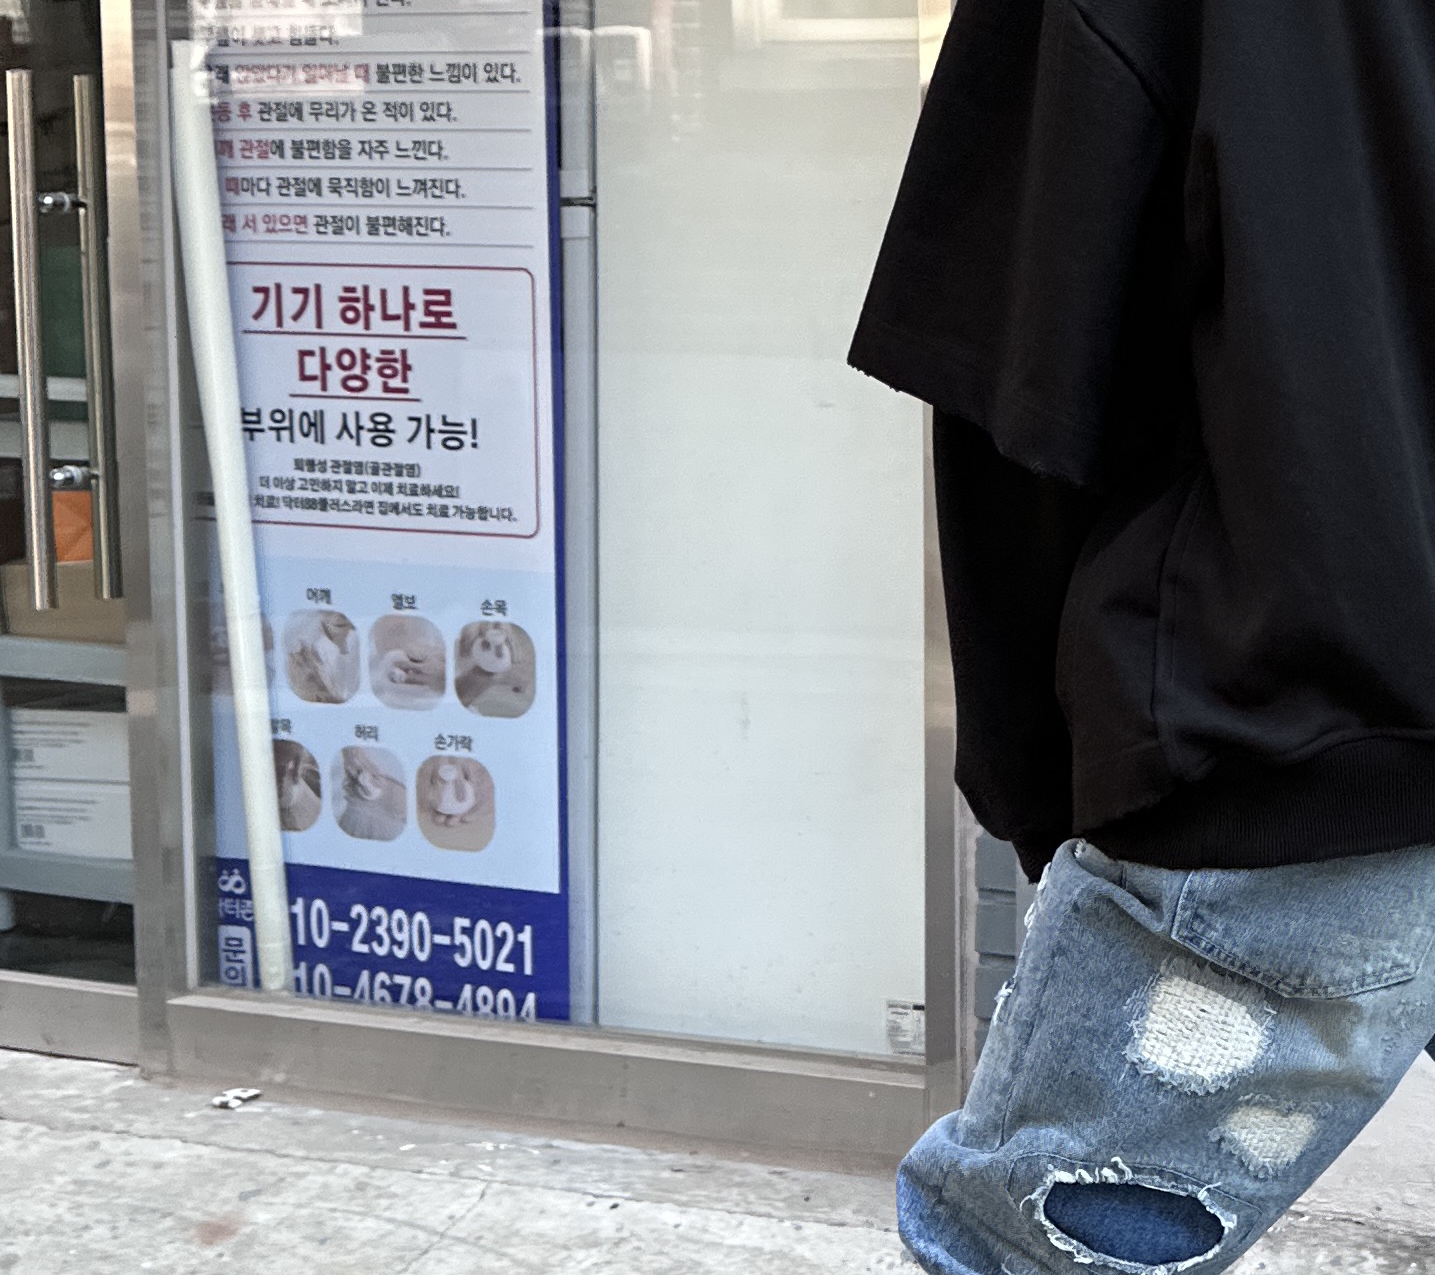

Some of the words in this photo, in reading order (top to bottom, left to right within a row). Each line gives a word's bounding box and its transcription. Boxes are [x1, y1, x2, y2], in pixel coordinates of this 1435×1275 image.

[376, 62, 424, 84] 불편한
[428, 62, 477, 83] 느낌이
[483, 62, 521, 83] 있다.
[237, 101, 252, 122] 후
[257, 101, 304, 123] 관절에
[309, 101, 357, 122] 무리가
[361, 101, 377, 122] 온
[383, 101, 414, 122] 적이
[419, 101, 458, 122] 있다.
[239, 139, 285, 160] 관절에
[291, 139, 353, 160] 불편함을
[358, 139, 390, 160] 자주
[395, 139, 450, 161] 느낀다.
[275, 176, 322, 198] 관절에
[328, 177, 391, 199] 묵직함이
[396, 178, 466, 199] 느껴진다.
[242, 214, 257, 233] 서
[261, 214, 308, 235] 있으면
[313, 214, 360, 236] 관절이
[366, 215, 451, 237] 불편해진다.
[251, 282, 323, 330] 기기
[338, 284, 458, 332] 하나로
[297, 346, 413, 395] 다양한
[241, 407, 326, 445] 부위에
[335, 410, 396, 448] 사용
[406, 413, 478, 452] 가능!
[480, 600, 508, 616] 손목
[354, 725, 379, 742] 허리
[434, 734, 473, 752] 손가락
[291, 897, 533, 976] 10-2390-5021
